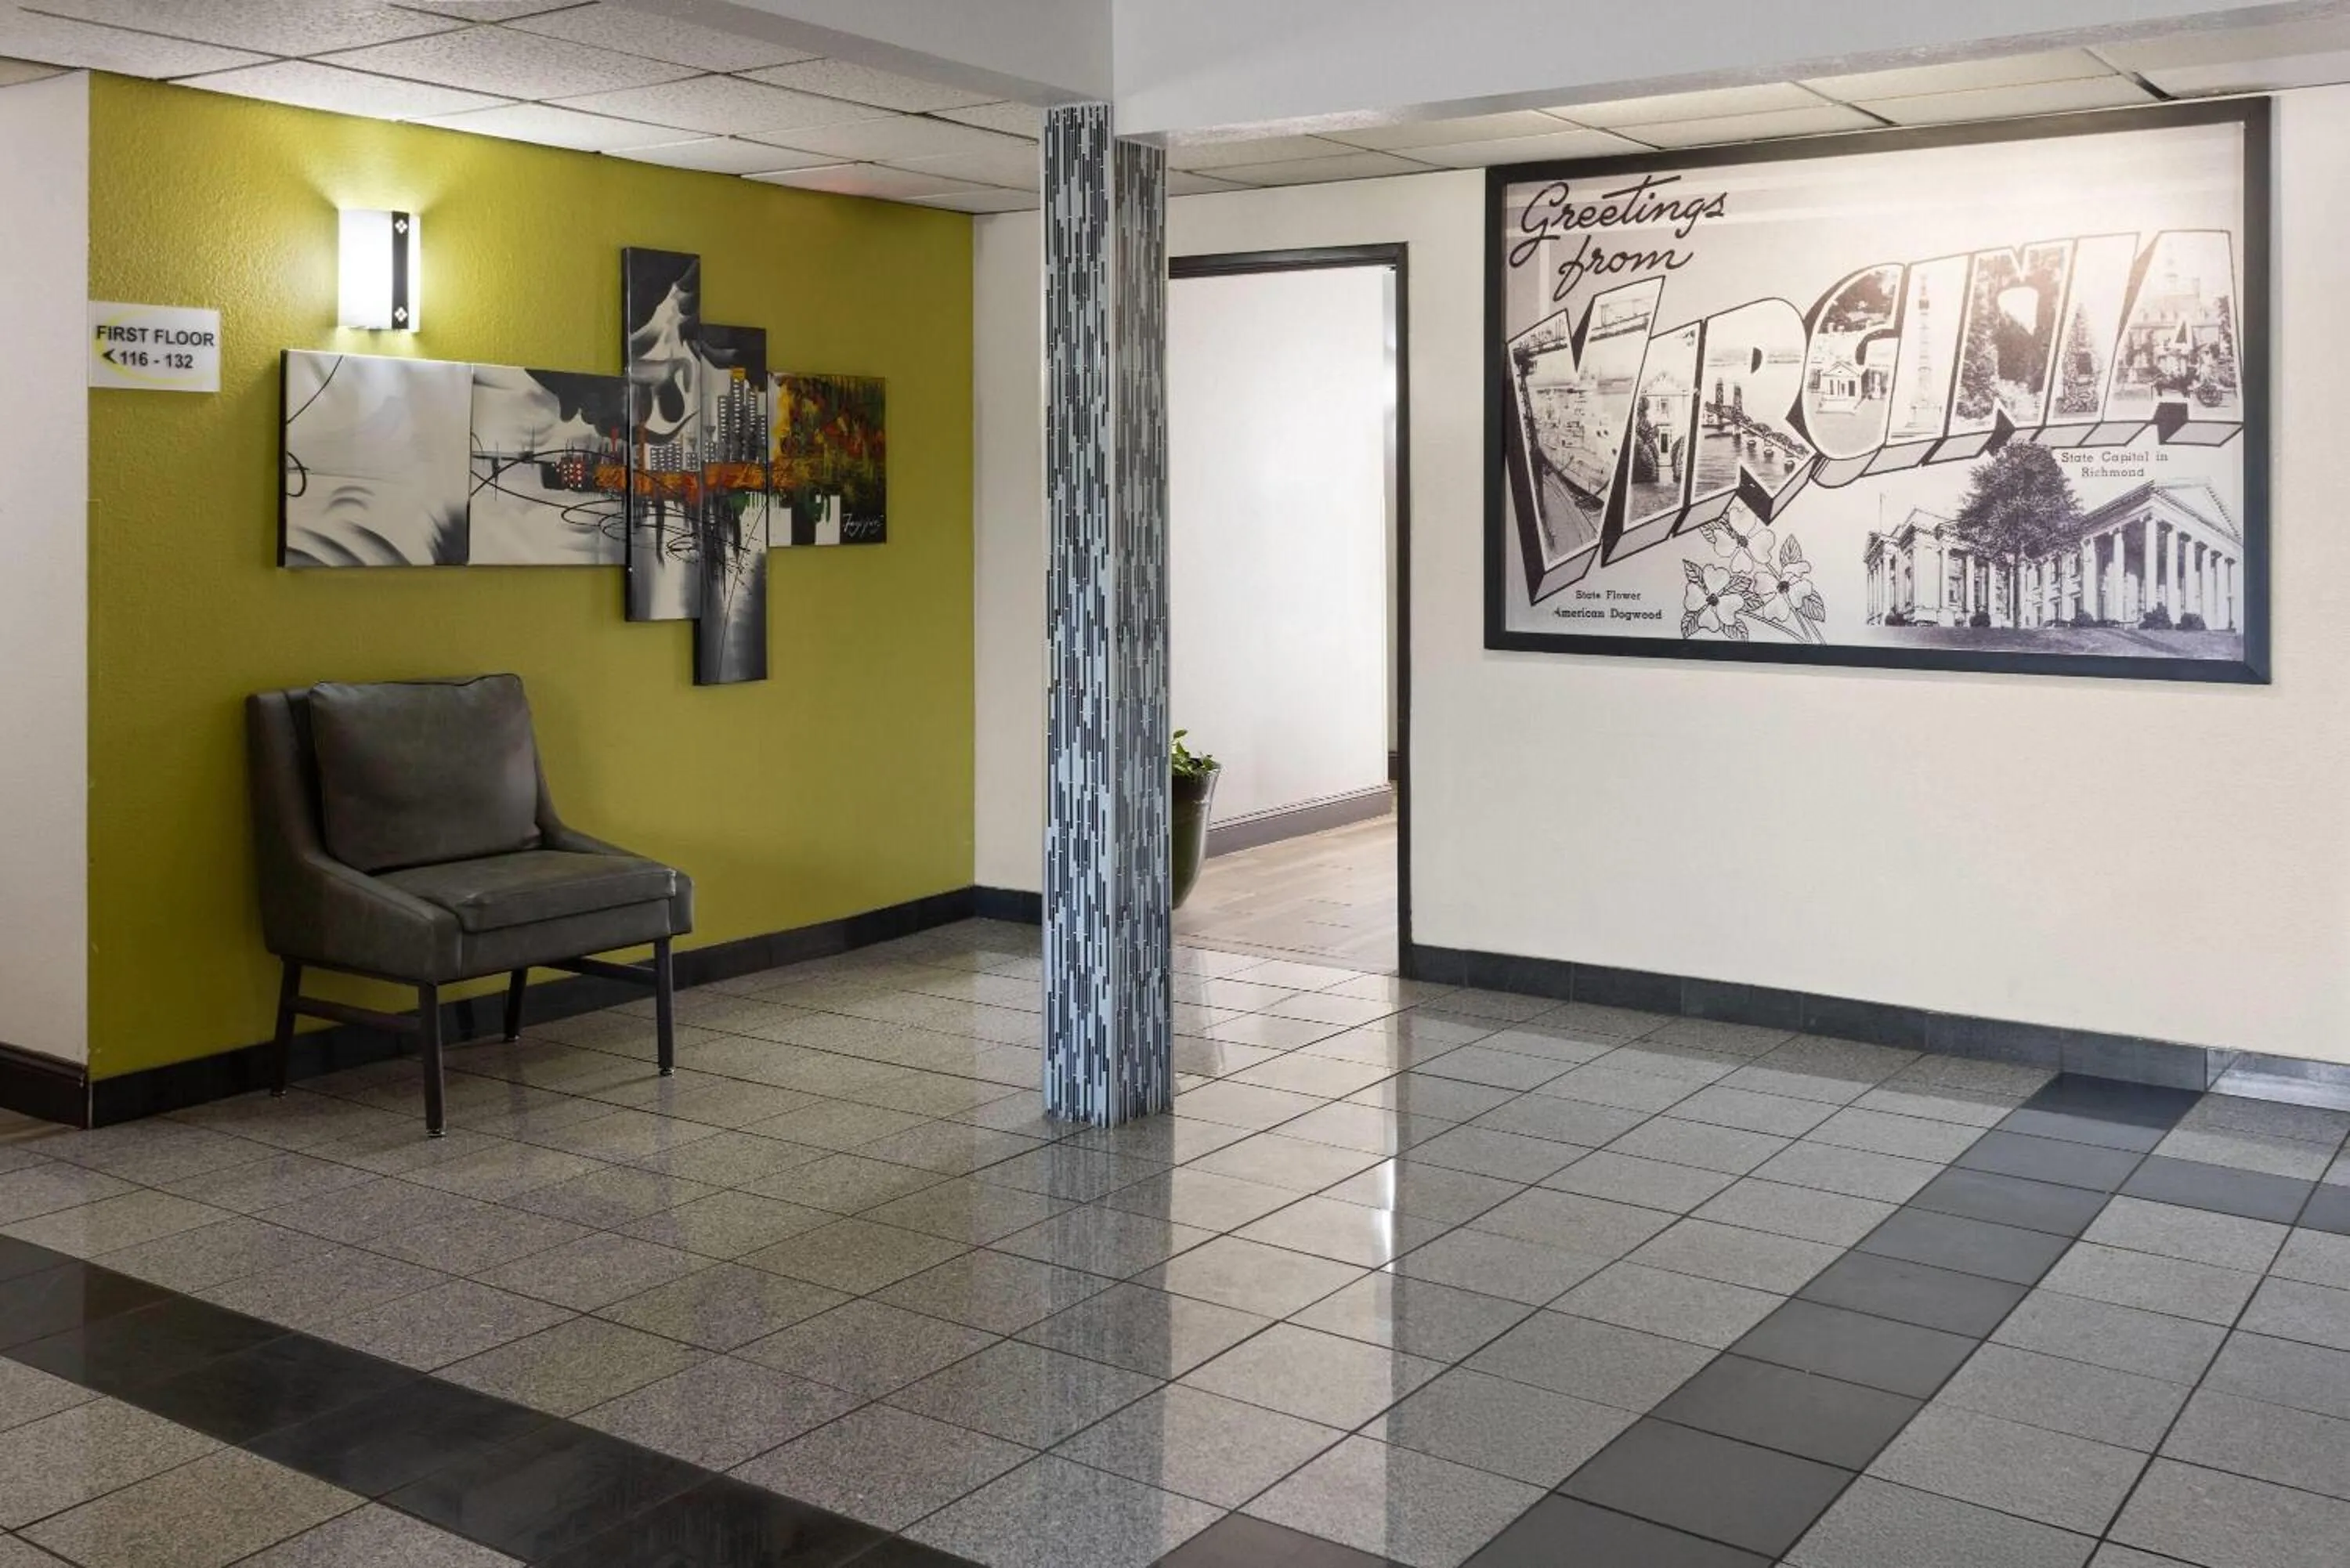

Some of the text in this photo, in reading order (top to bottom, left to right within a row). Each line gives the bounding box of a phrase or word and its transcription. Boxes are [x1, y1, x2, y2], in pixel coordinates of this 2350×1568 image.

[1509, 175, 1728, 268] Greetings
[1552, 234, 1694, 302] from
[95, 325, 215, 347] FIRST FLOOR
[120, 351, 149, 367] 116
[164, 353, 194, 370] 132
[1506, 229, 2243, 605] VIRGINIA
[2061, 451, 2095, 464] State
[2155, 452, 2169, 462] in
[2081, 467, 2145, 478] Richmond
[1574, 589, 1642, 601] State Flower
[1553, 607, 1663, 621] American Dogwood
